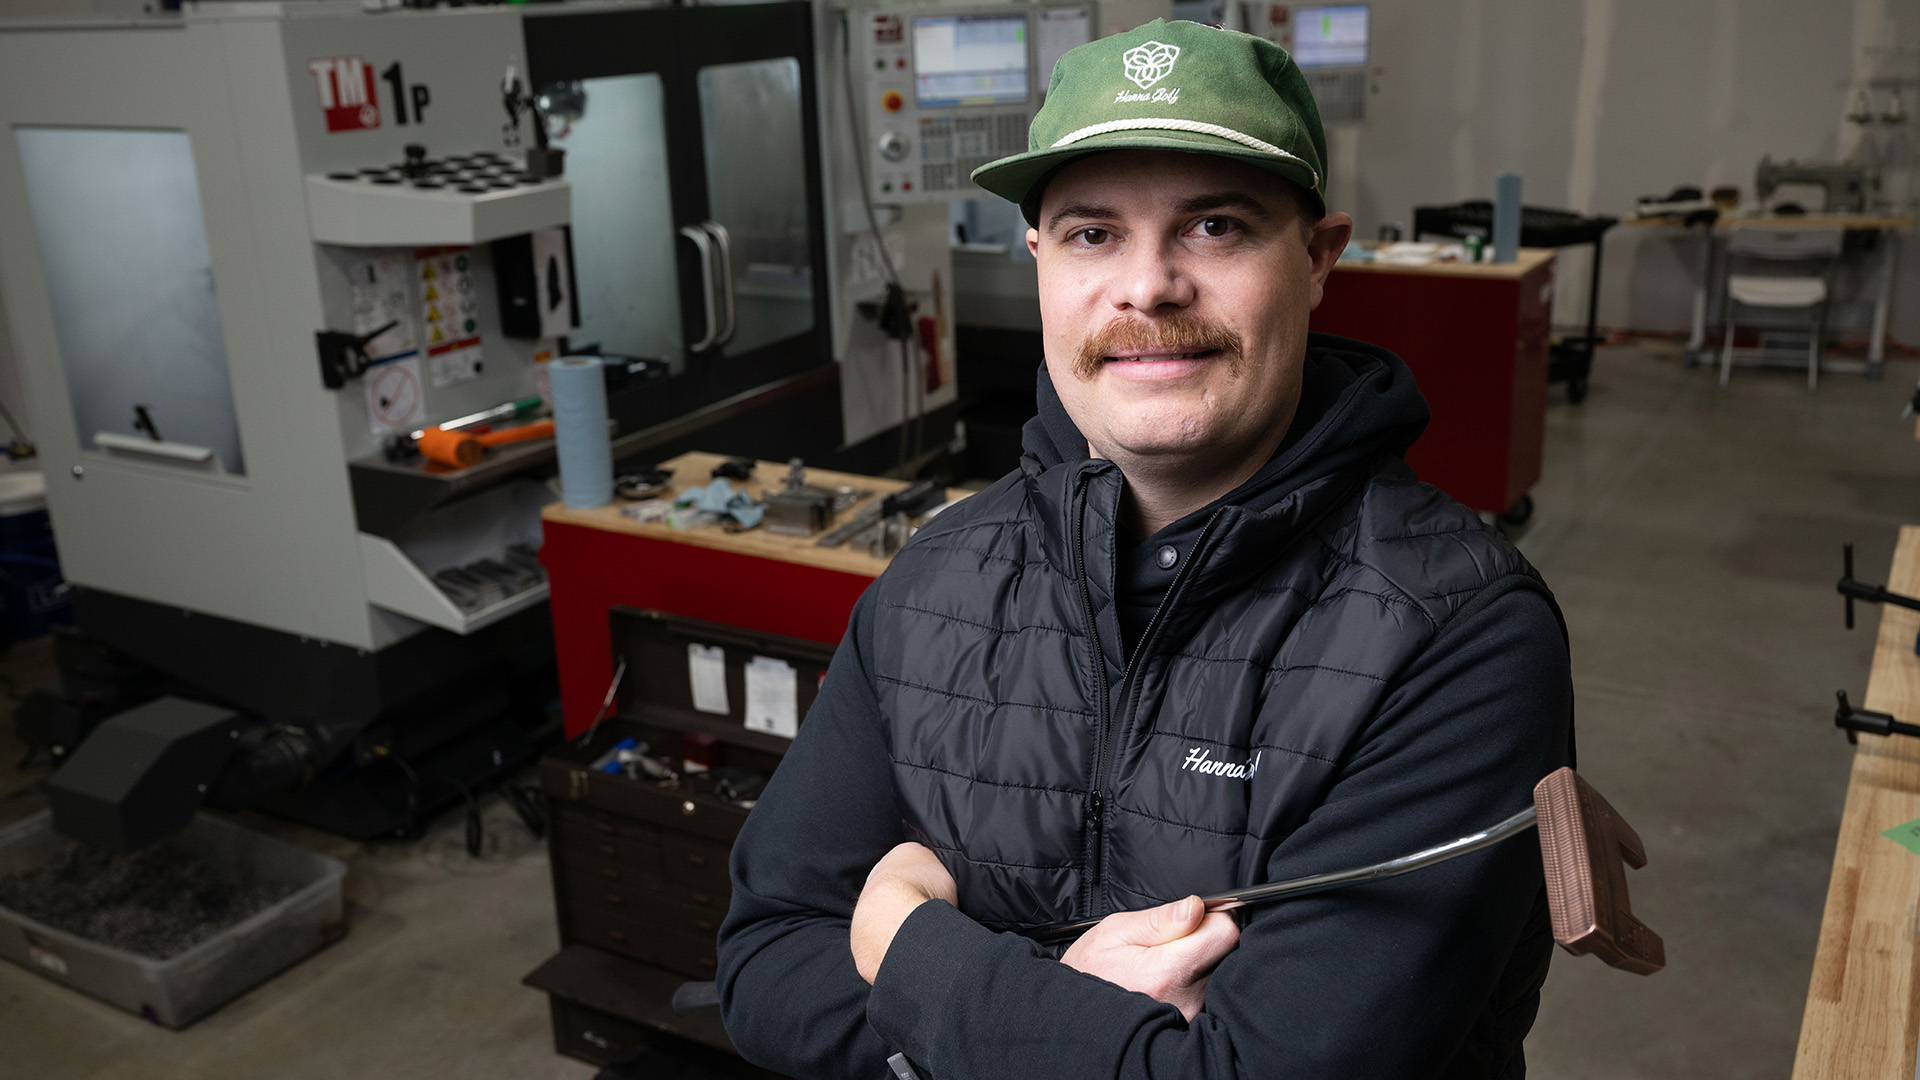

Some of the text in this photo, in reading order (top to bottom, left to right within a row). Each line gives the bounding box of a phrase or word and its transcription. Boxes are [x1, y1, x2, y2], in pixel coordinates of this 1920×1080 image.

[308, 56, 367, 109] TM
[1113, 87, 1181, 105] Hanna Golf
[1181, 747, 1246, 779] Hanna
